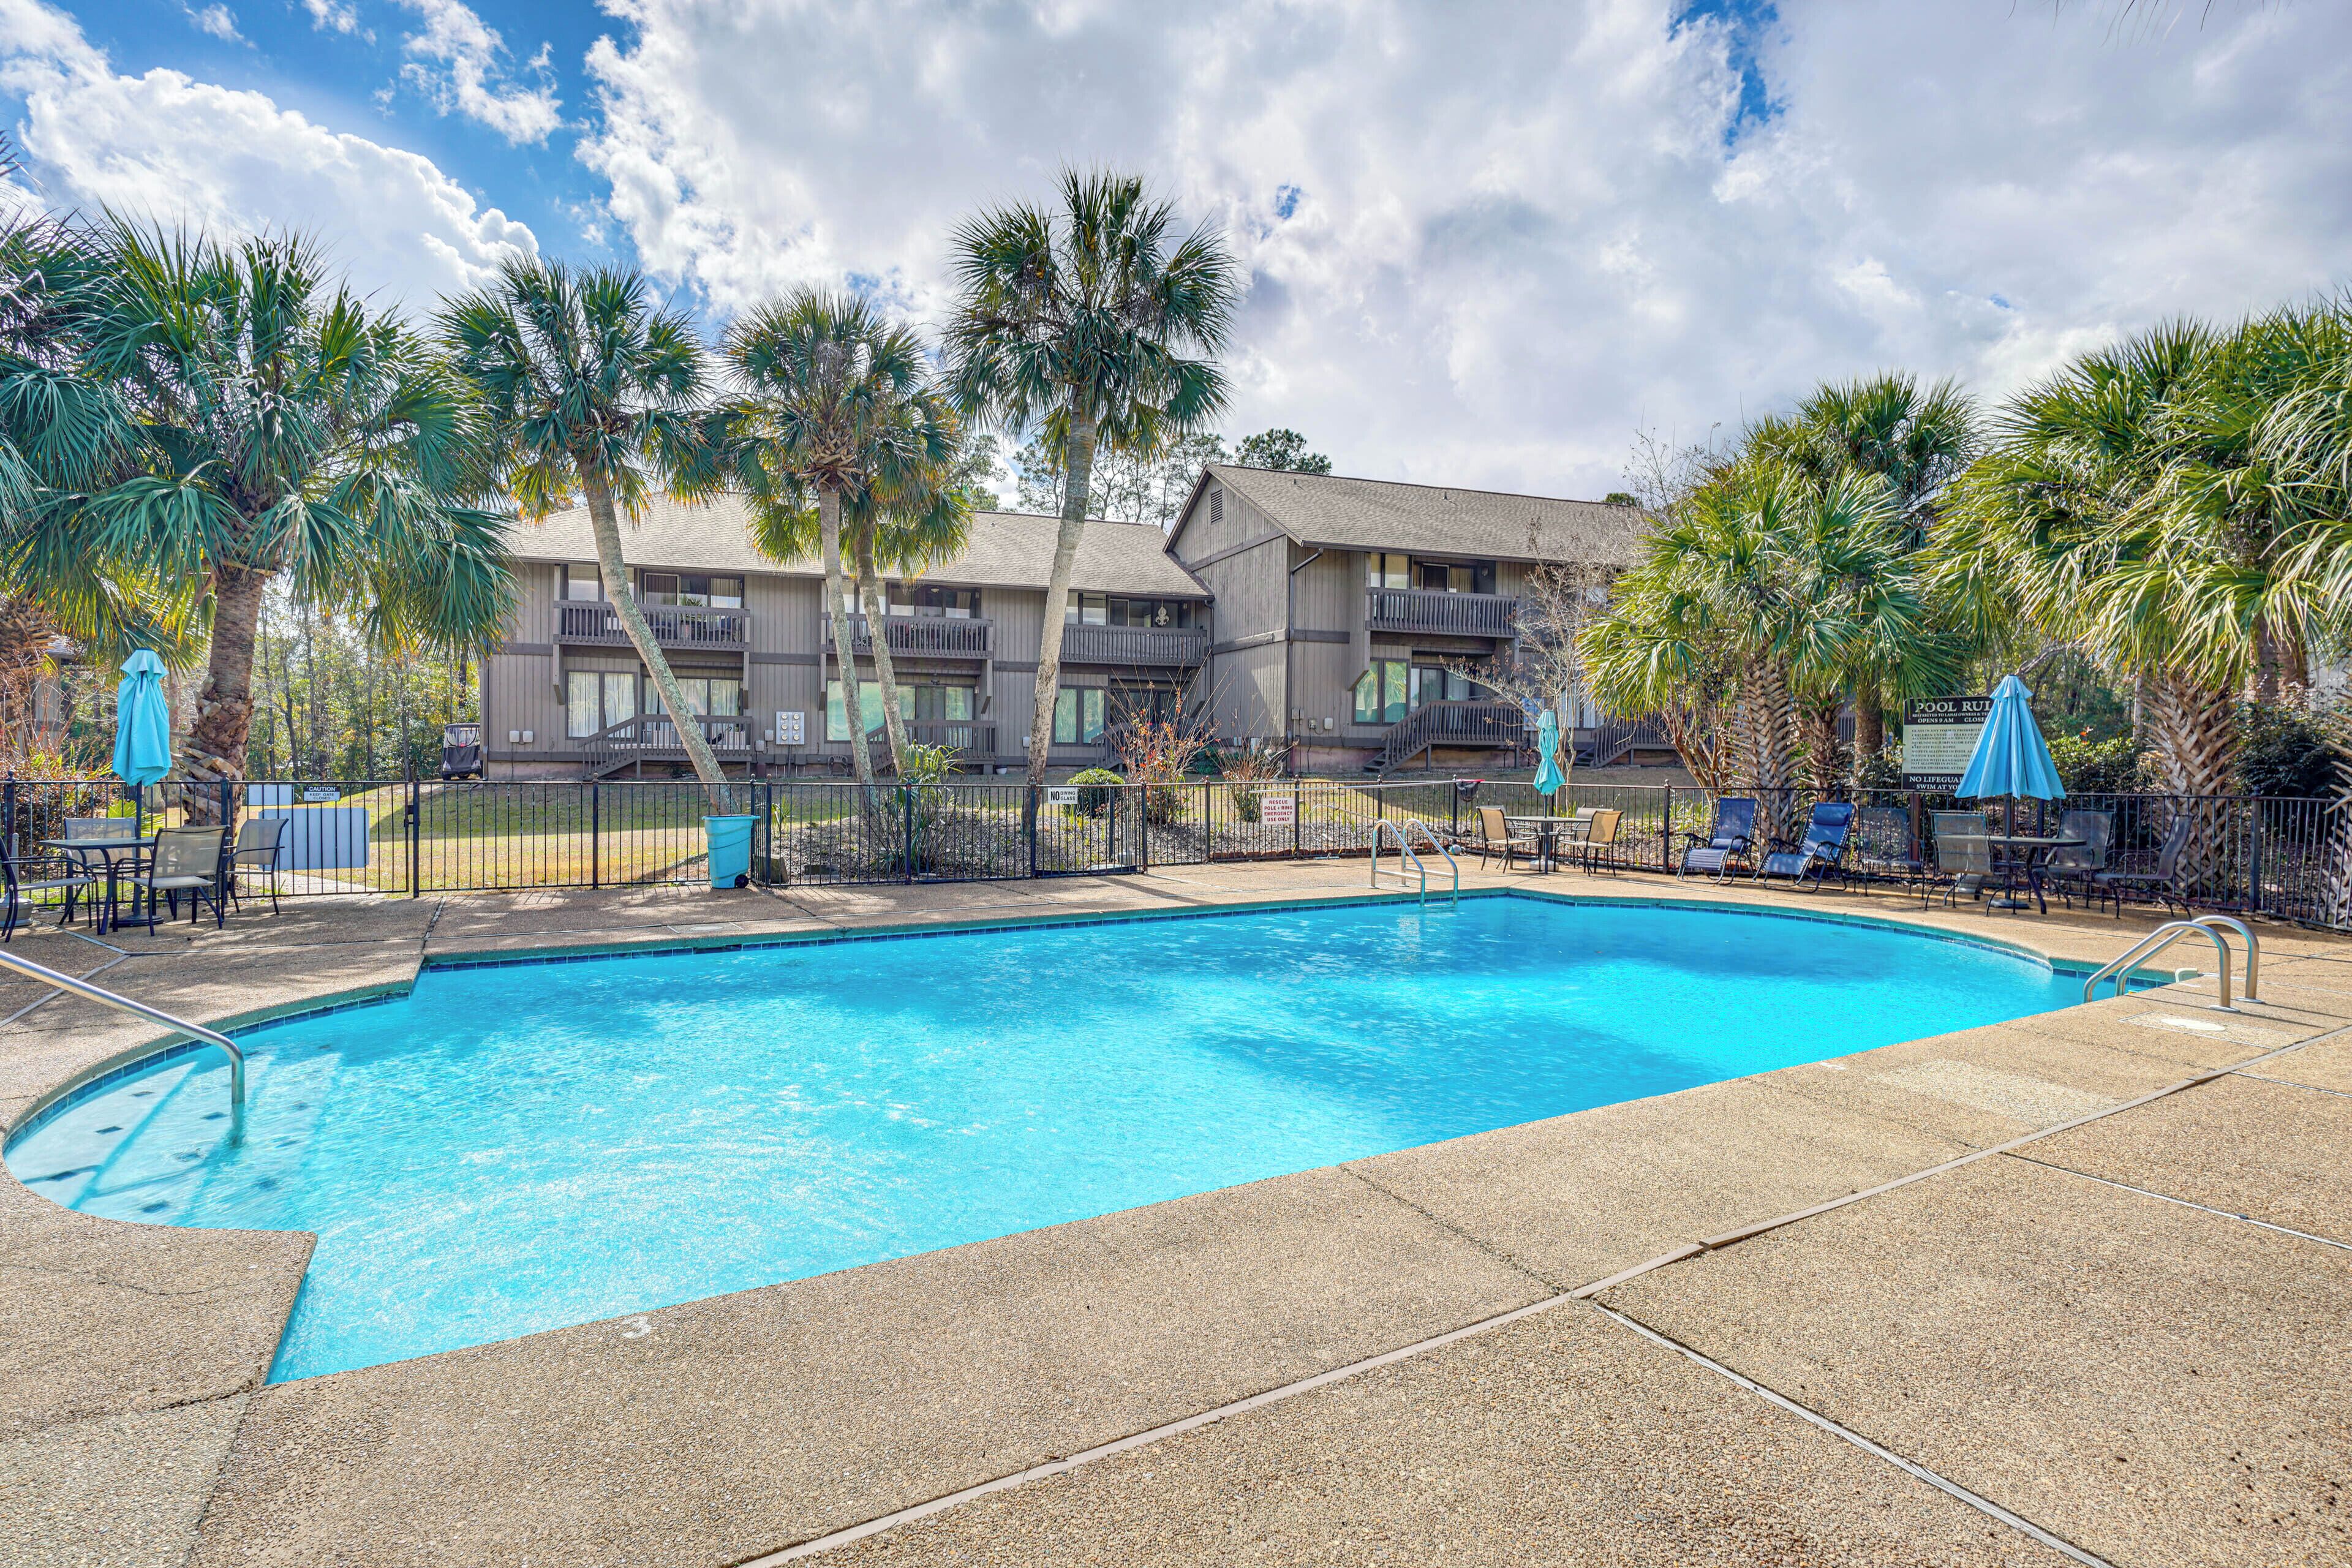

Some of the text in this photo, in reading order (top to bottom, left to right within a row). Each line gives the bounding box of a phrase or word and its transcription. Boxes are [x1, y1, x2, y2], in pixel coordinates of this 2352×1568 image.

[1915, 701, 1957, 713] POOL
[1050, 791, 1060, 801] NO
[621, 1316, 653, 1339] 3
